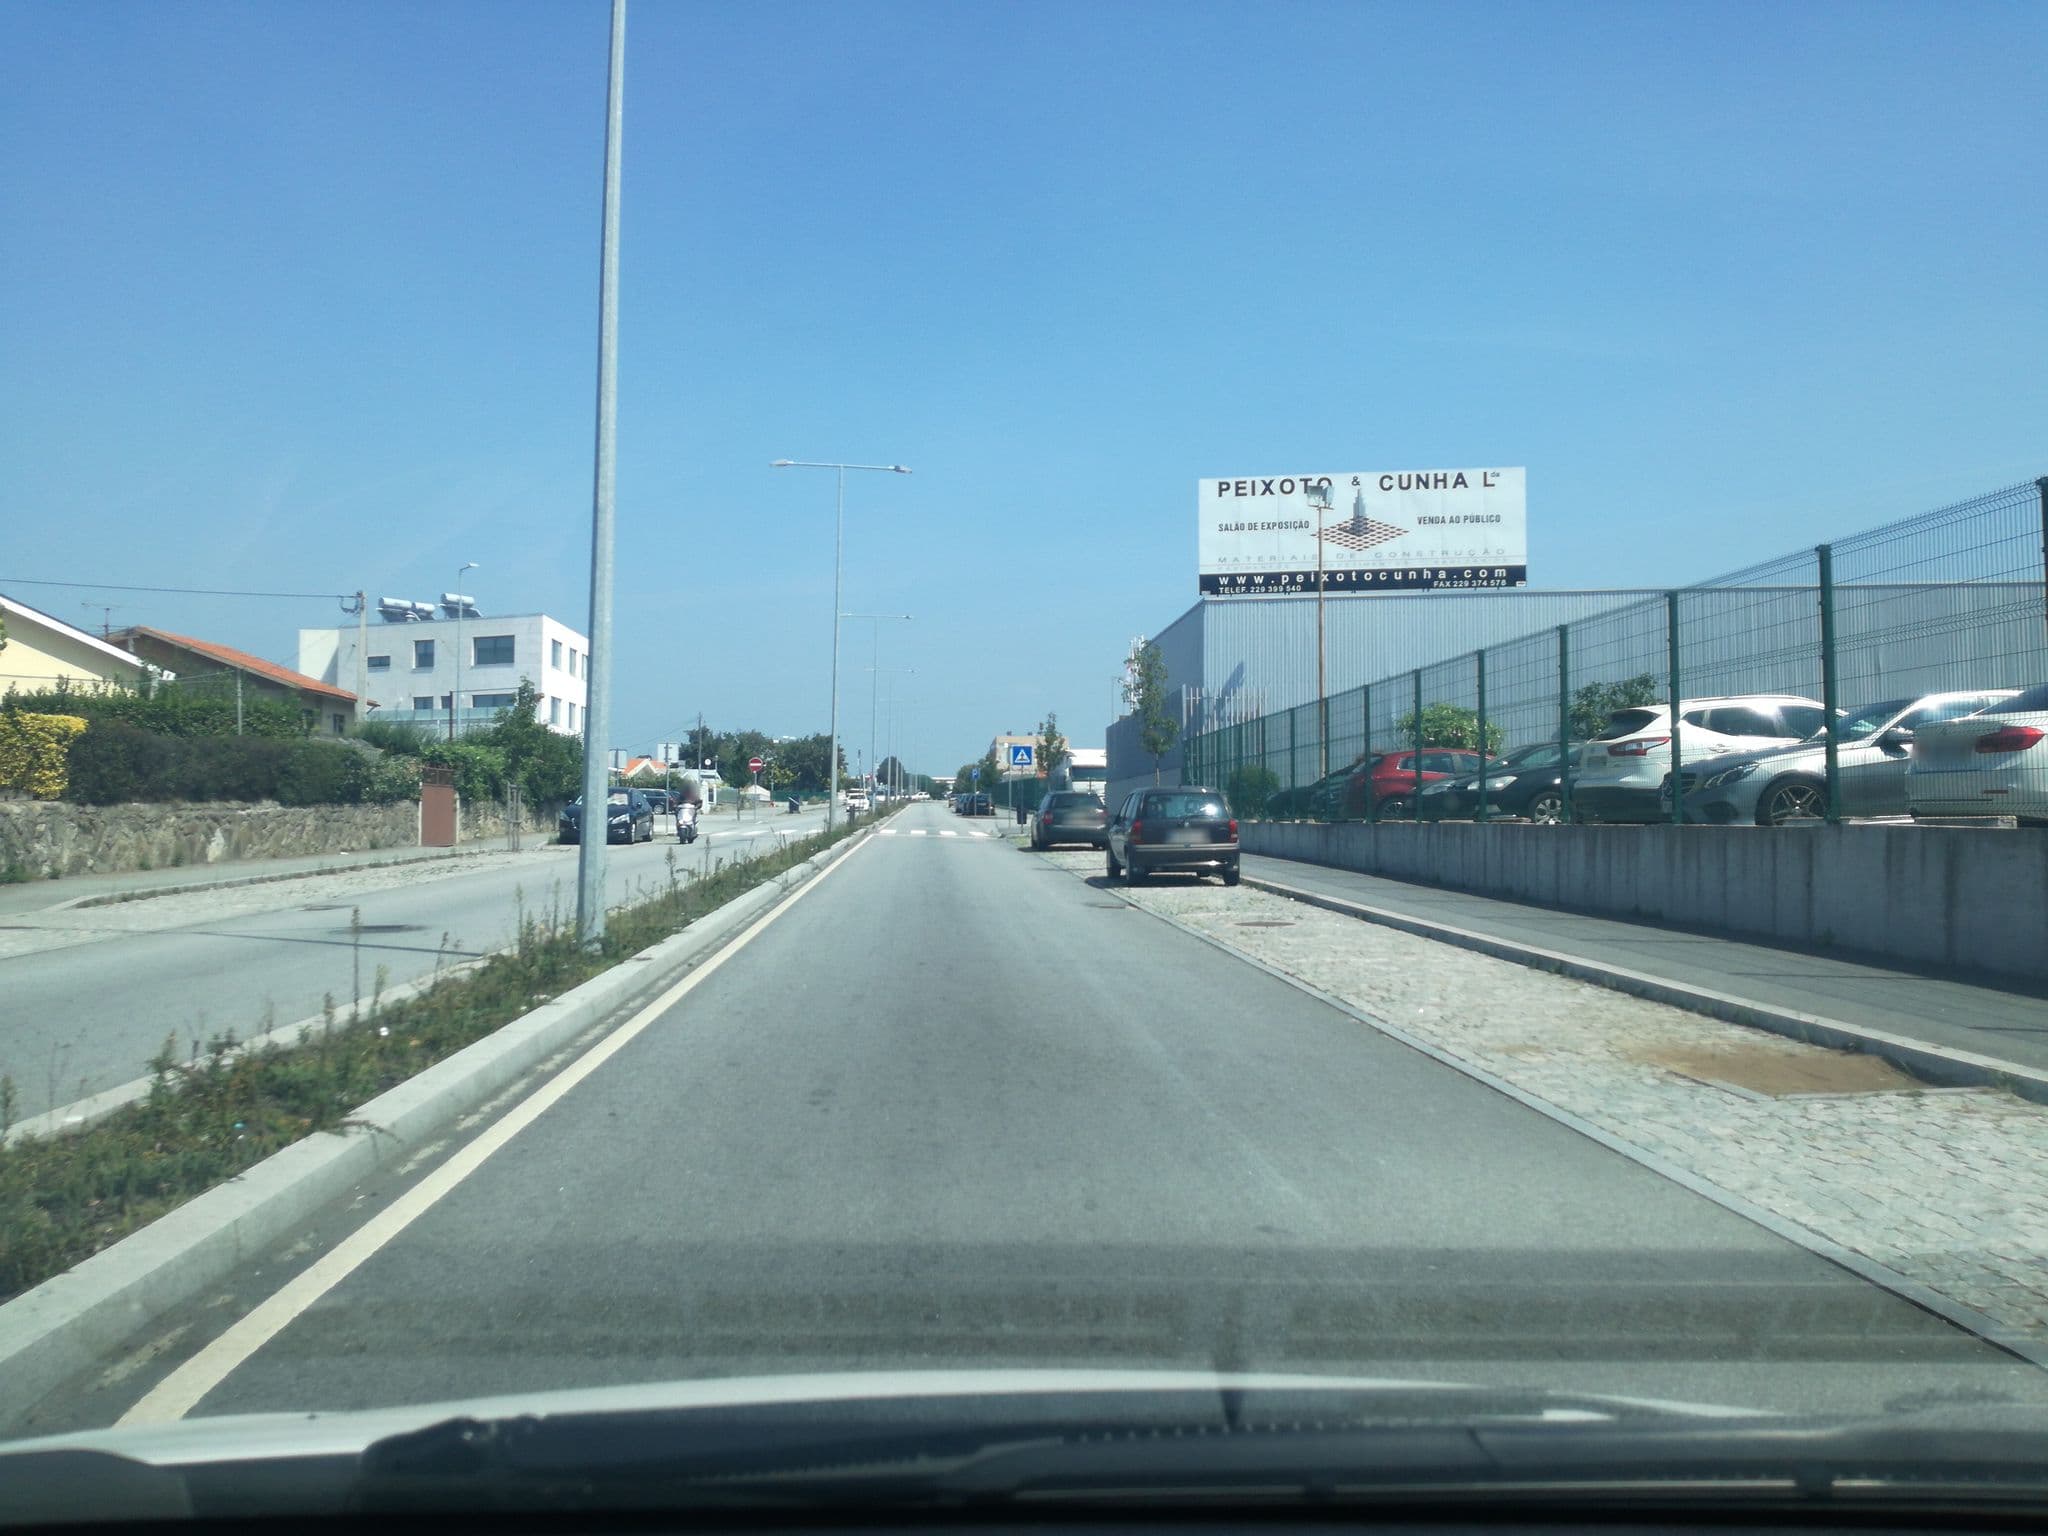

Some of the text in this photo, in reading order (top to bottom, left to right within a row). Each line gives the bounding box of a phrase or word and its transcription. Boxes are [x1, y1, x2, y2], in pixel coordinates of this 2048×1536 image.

[1218, 477, 1332, 497] PEIXOTO
[1352, 476, 1360, 486] &
[1379, 472, 1468, 491] CUNHA
[1248, 522, 1258, 531] DE
[1417, 516, 1446, 525] VENDA
[1449, 515, 1460, 524] AO
[1218, 568, 1506, 585] www.peixotocunha.com
